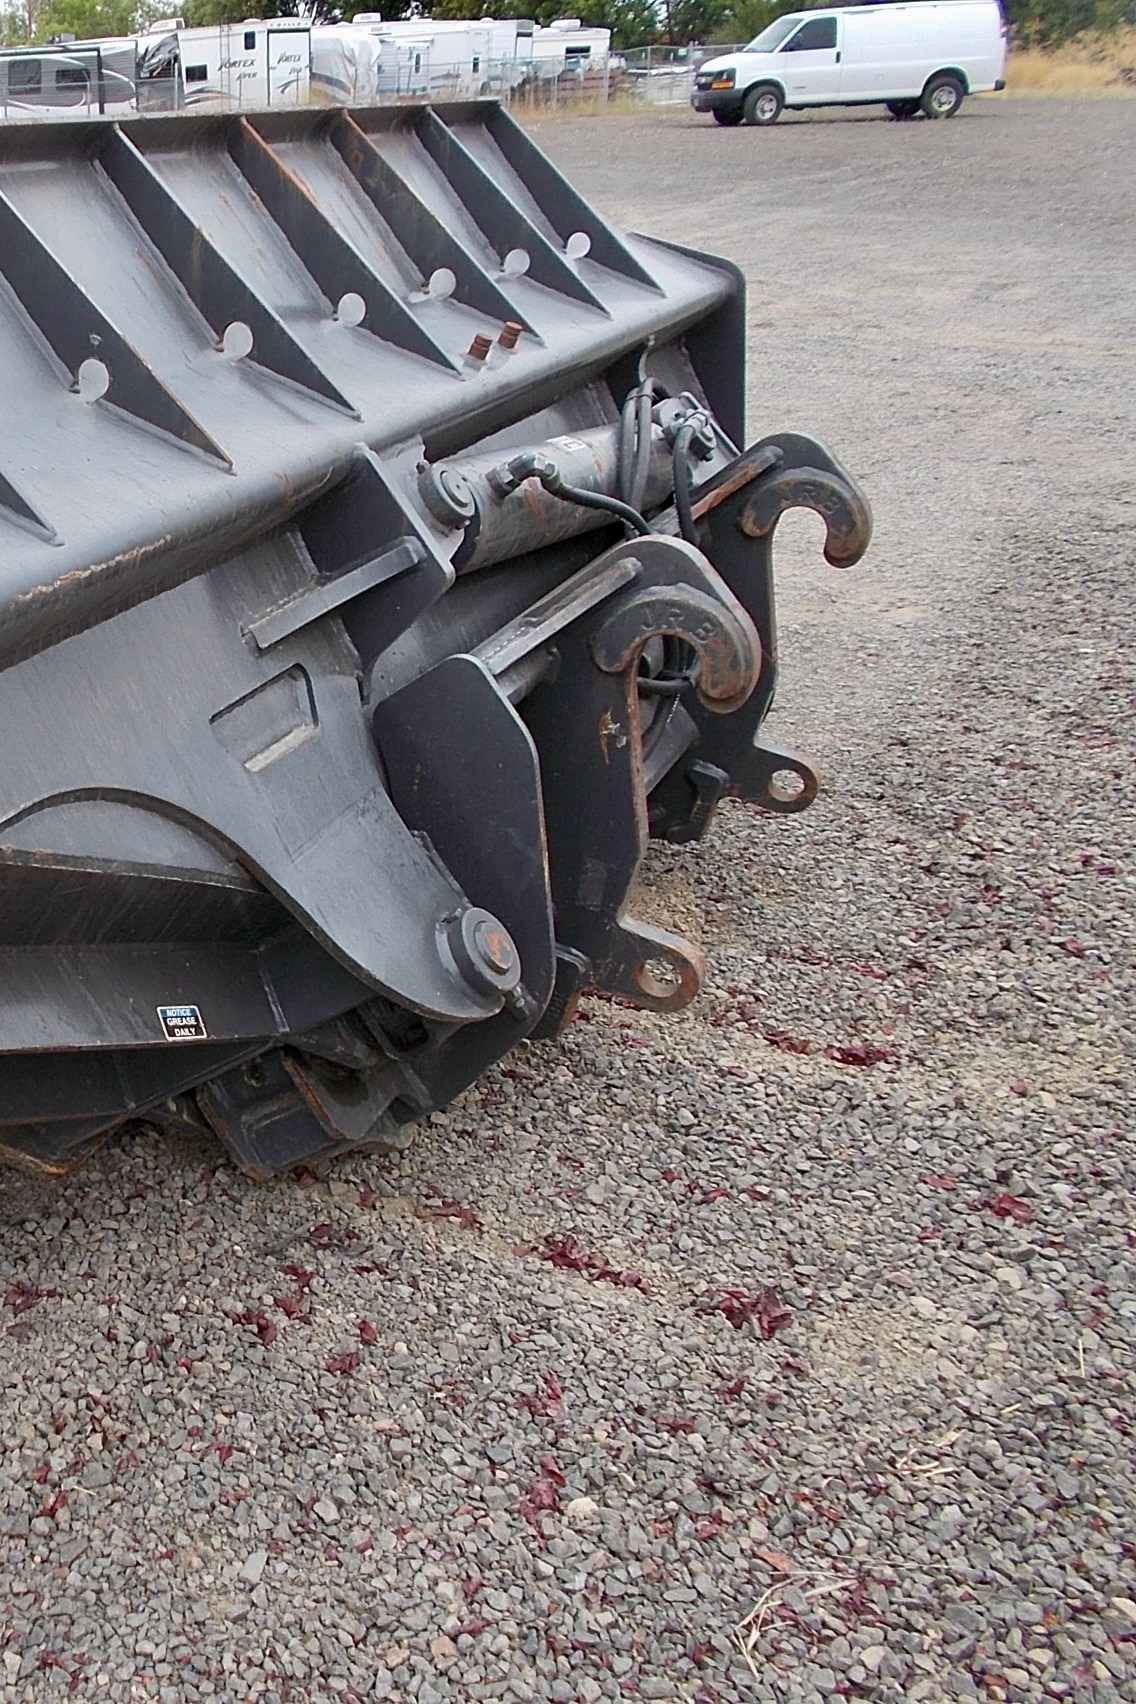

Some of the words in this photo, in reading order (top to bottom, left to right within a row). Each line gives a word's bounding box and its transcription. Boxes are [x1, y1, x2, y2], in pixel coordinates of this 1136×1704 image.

[217, 57, 256, 71] VORTEX
[166, 1009, 192, 1017] NOTICE
[166, 1016, 197, 1026] GREASE
[174, 1027, 196, 1037] DAILY
